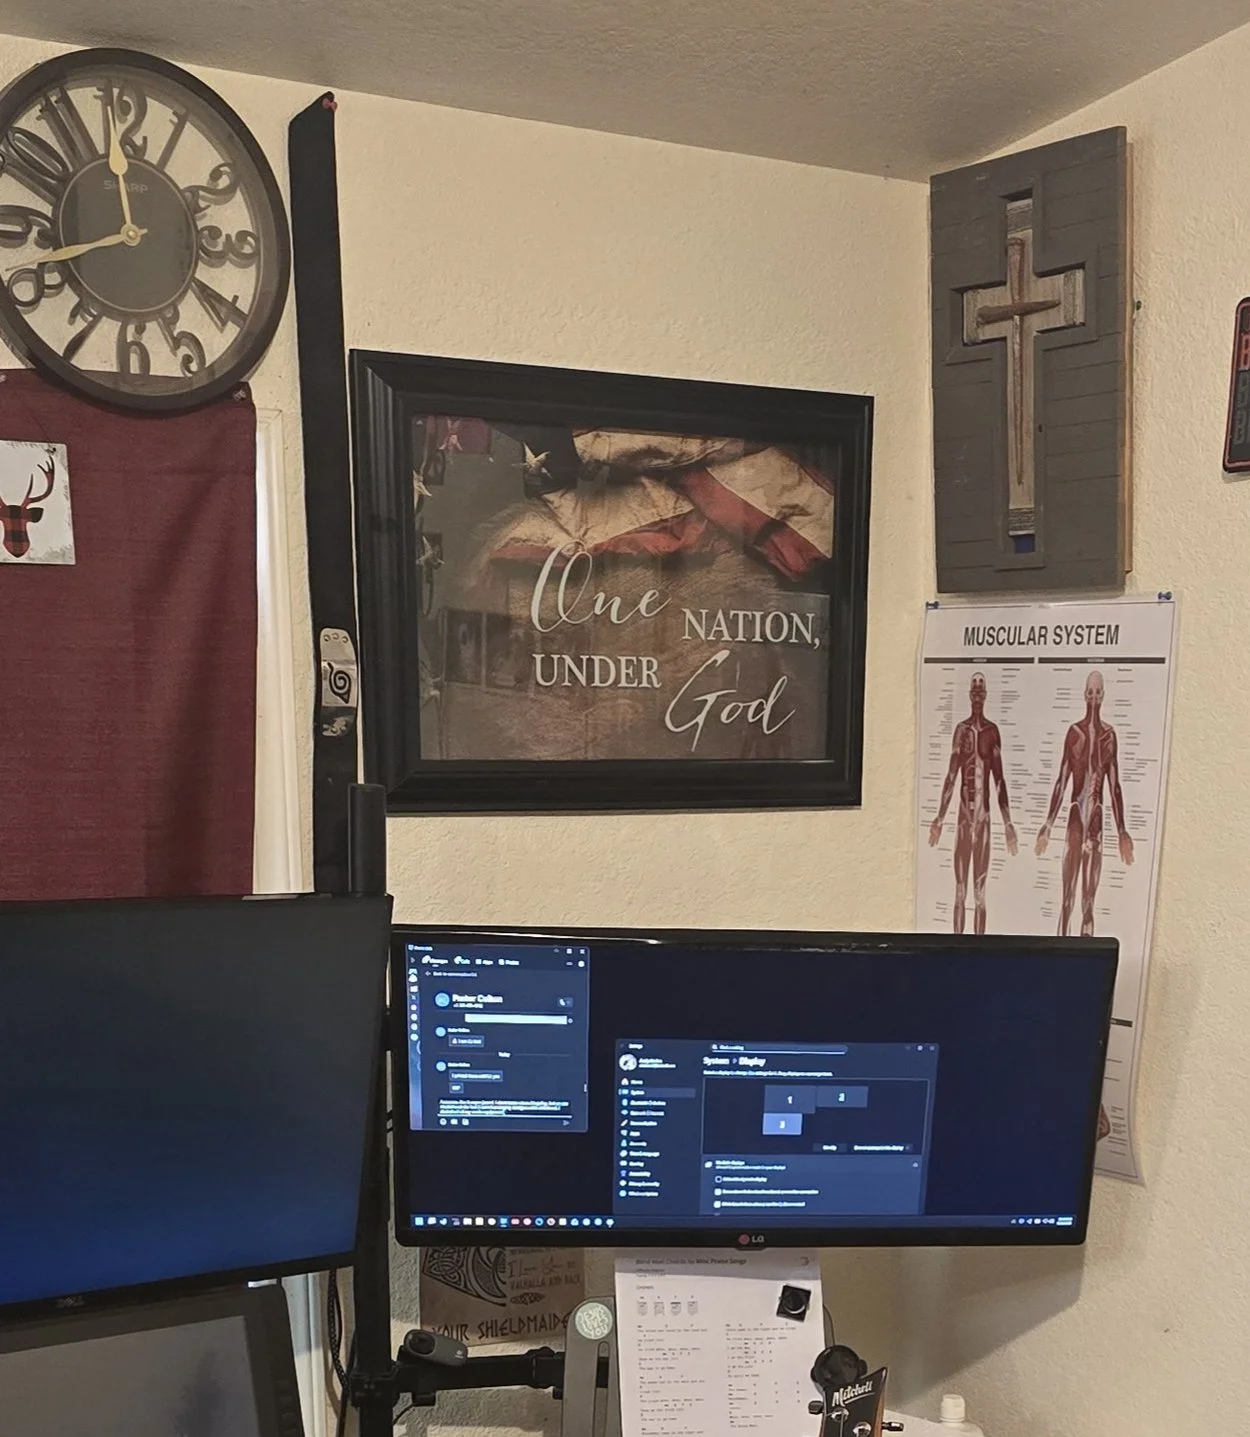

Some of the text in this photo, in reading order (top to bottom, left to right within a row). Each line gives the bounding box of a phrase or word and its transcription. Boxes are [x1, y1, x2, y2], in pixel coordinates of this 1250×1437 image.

[37, 86, 100, 162] 11
[93, 78, 148, 160] 12
[169, 108, 190, 173] 1
[103, 180, 149, 194] SHARP
[182, 162, 240, 216] 2
[198, 225, 259, 268] 3
[7, 260, 69, 310] 8
[190, 276, 249, 332] 4
[62, 300, 103, 361] 7
[117, 318, 150, 380] 6
[156, 304, 207, 377] 5
[530, 539, 671, 633] One
[681, 608, 820, 650] NATION,
[964, 624, 1120, 646] MUSCULAR SYSTEM
[532, 653, 661, 689] UNDER
[664, 649, 796, 752] God
[787, 1096, 793, 1104] 1
[752, 1235, 765, 1243] LG
[432, 1312, 569, 1341] YOUR SHIELDMAIDE
[831, 1380, 875, 1408] Mitchell
